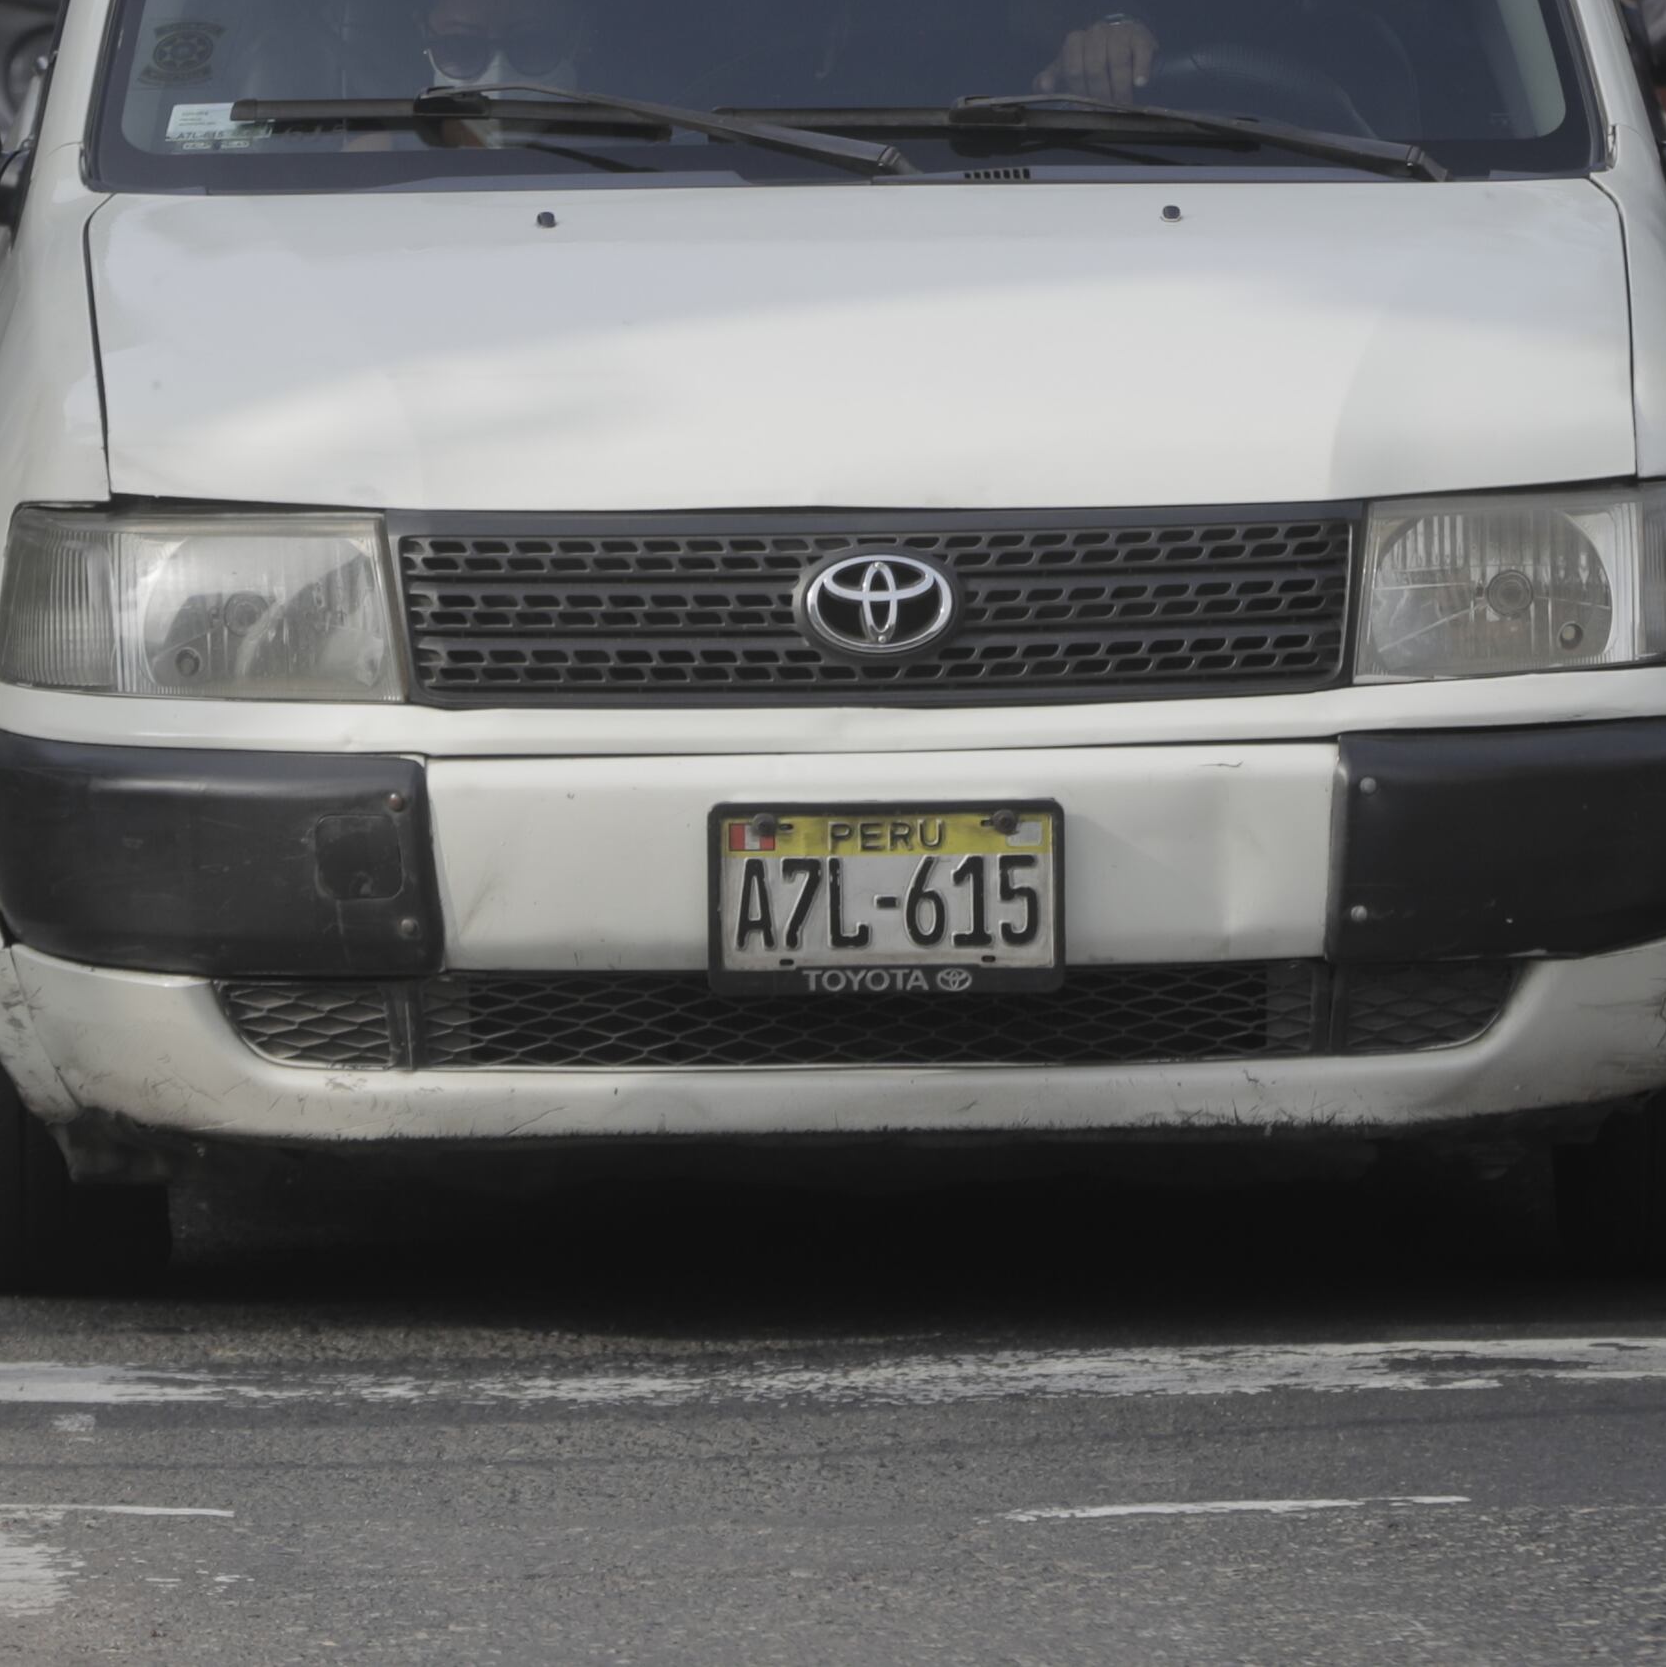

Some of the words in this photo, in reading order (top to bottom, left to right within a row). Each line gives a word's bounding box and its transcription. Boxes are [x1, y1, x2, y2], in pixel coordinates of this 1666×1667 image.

[827, 819, 946, 852] PERU
[736, 854, 1040, 950] A7L-615
[802, 968, 930, 992] TOYOTA
